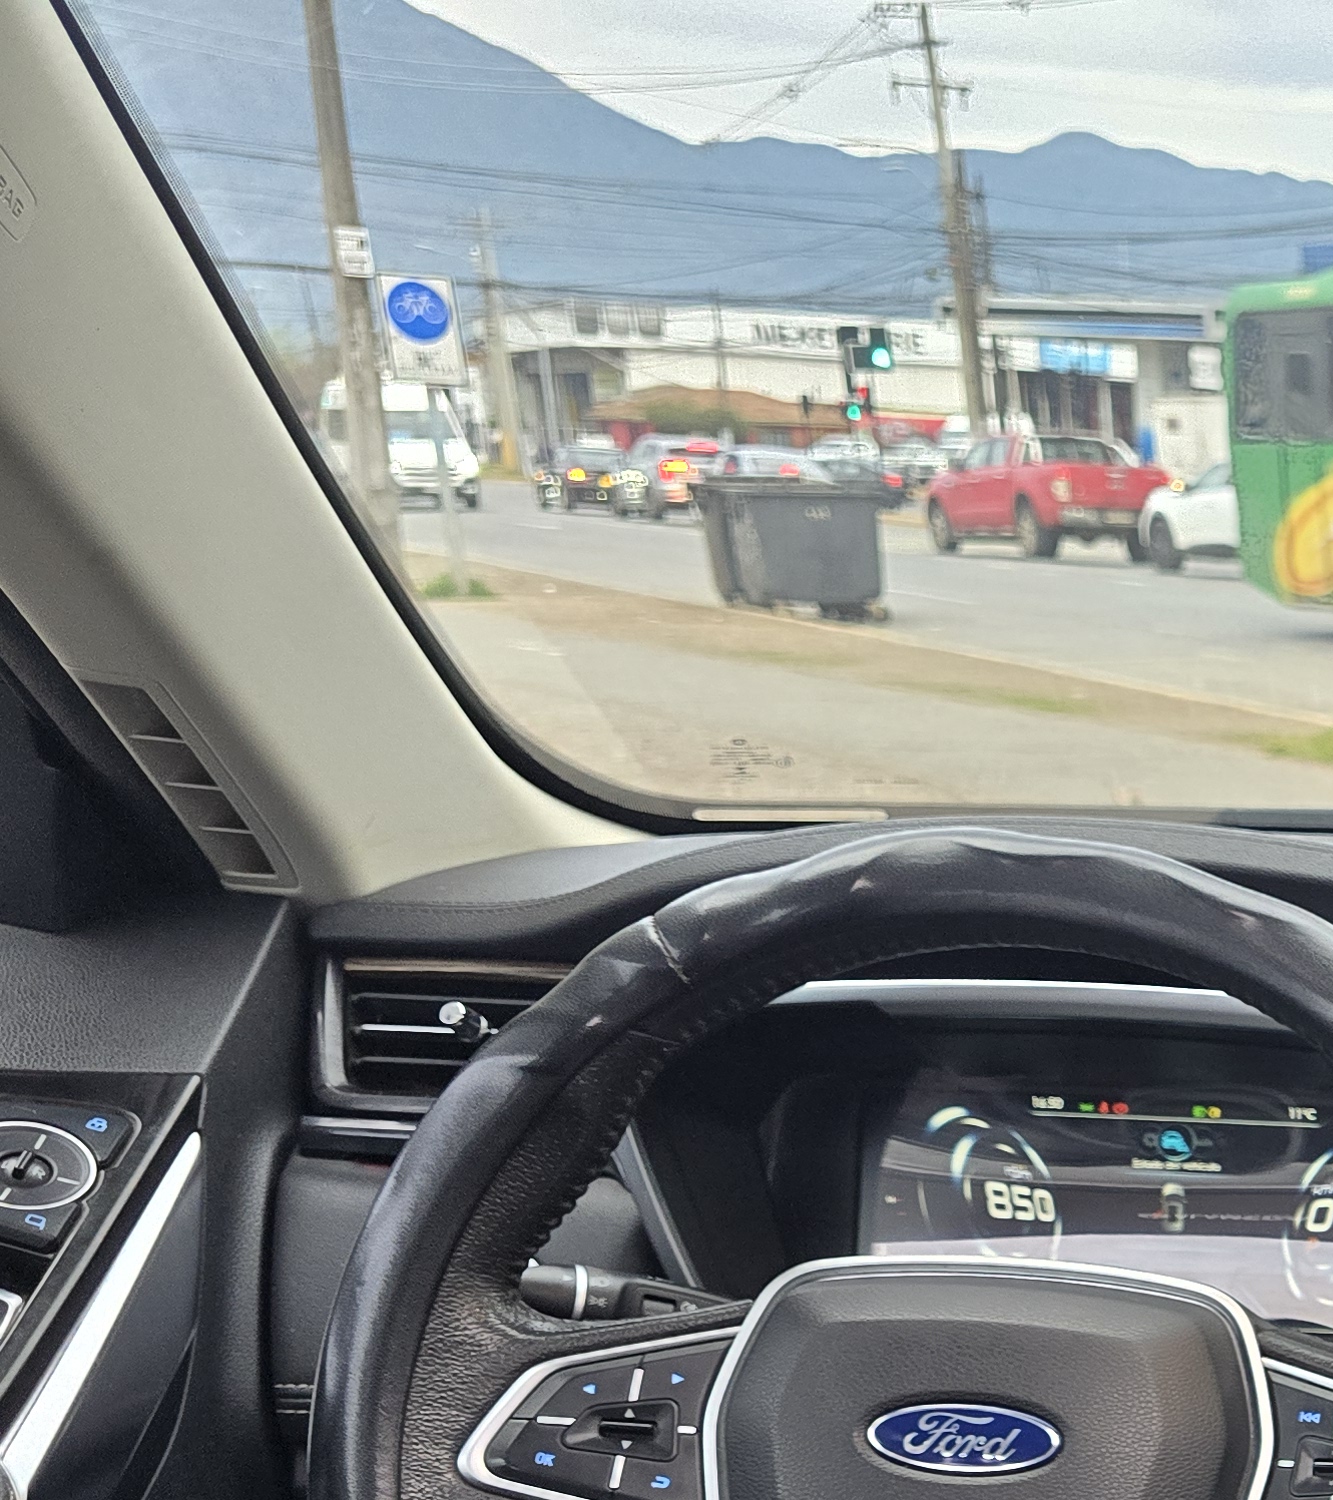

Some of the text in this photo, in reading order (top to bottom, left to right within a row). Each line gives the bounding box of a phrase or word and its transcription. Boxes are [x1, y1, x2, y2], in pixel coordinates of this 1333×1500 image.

[984, 1180, 1056, 1222] 850
[903, 1411, 1021, 1461] Ford
[534, 1451, 556, 1467] OK
